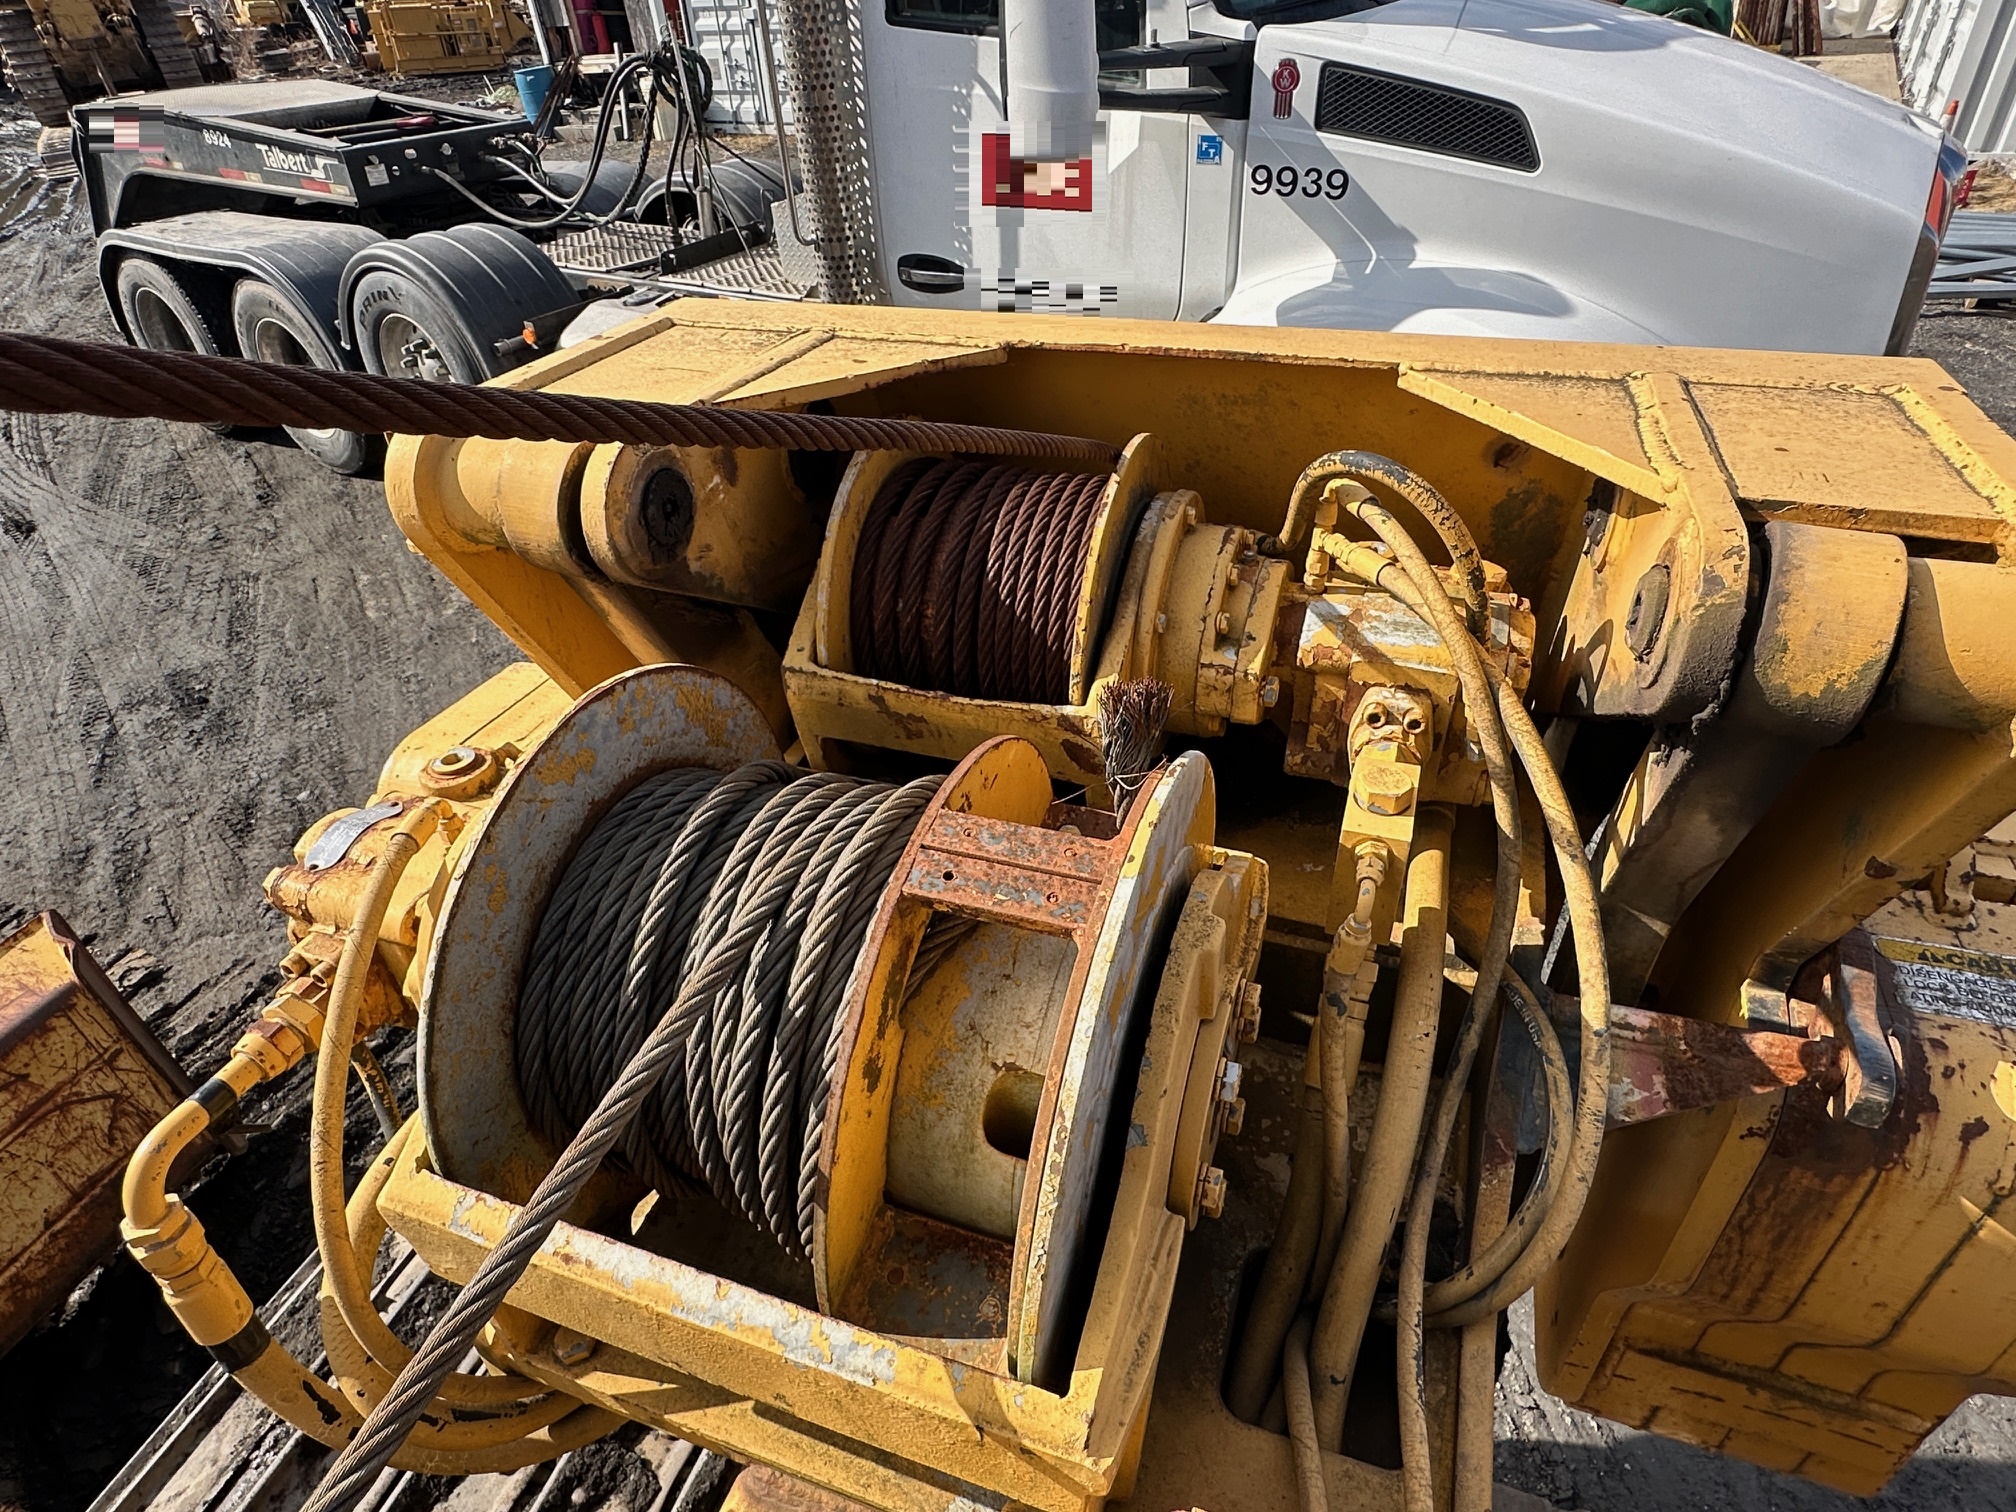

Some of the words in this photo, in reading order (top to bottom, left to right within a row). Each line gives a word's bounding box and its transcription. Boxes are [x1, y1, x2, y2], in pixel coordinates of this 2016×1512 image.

[203, 128, 232, 149] 8924
[254, 143, 312, 173] Talbert
[1250, 164, 1350, 200] 9939
[1898, 965, 1997, 990] DISENGAGE
